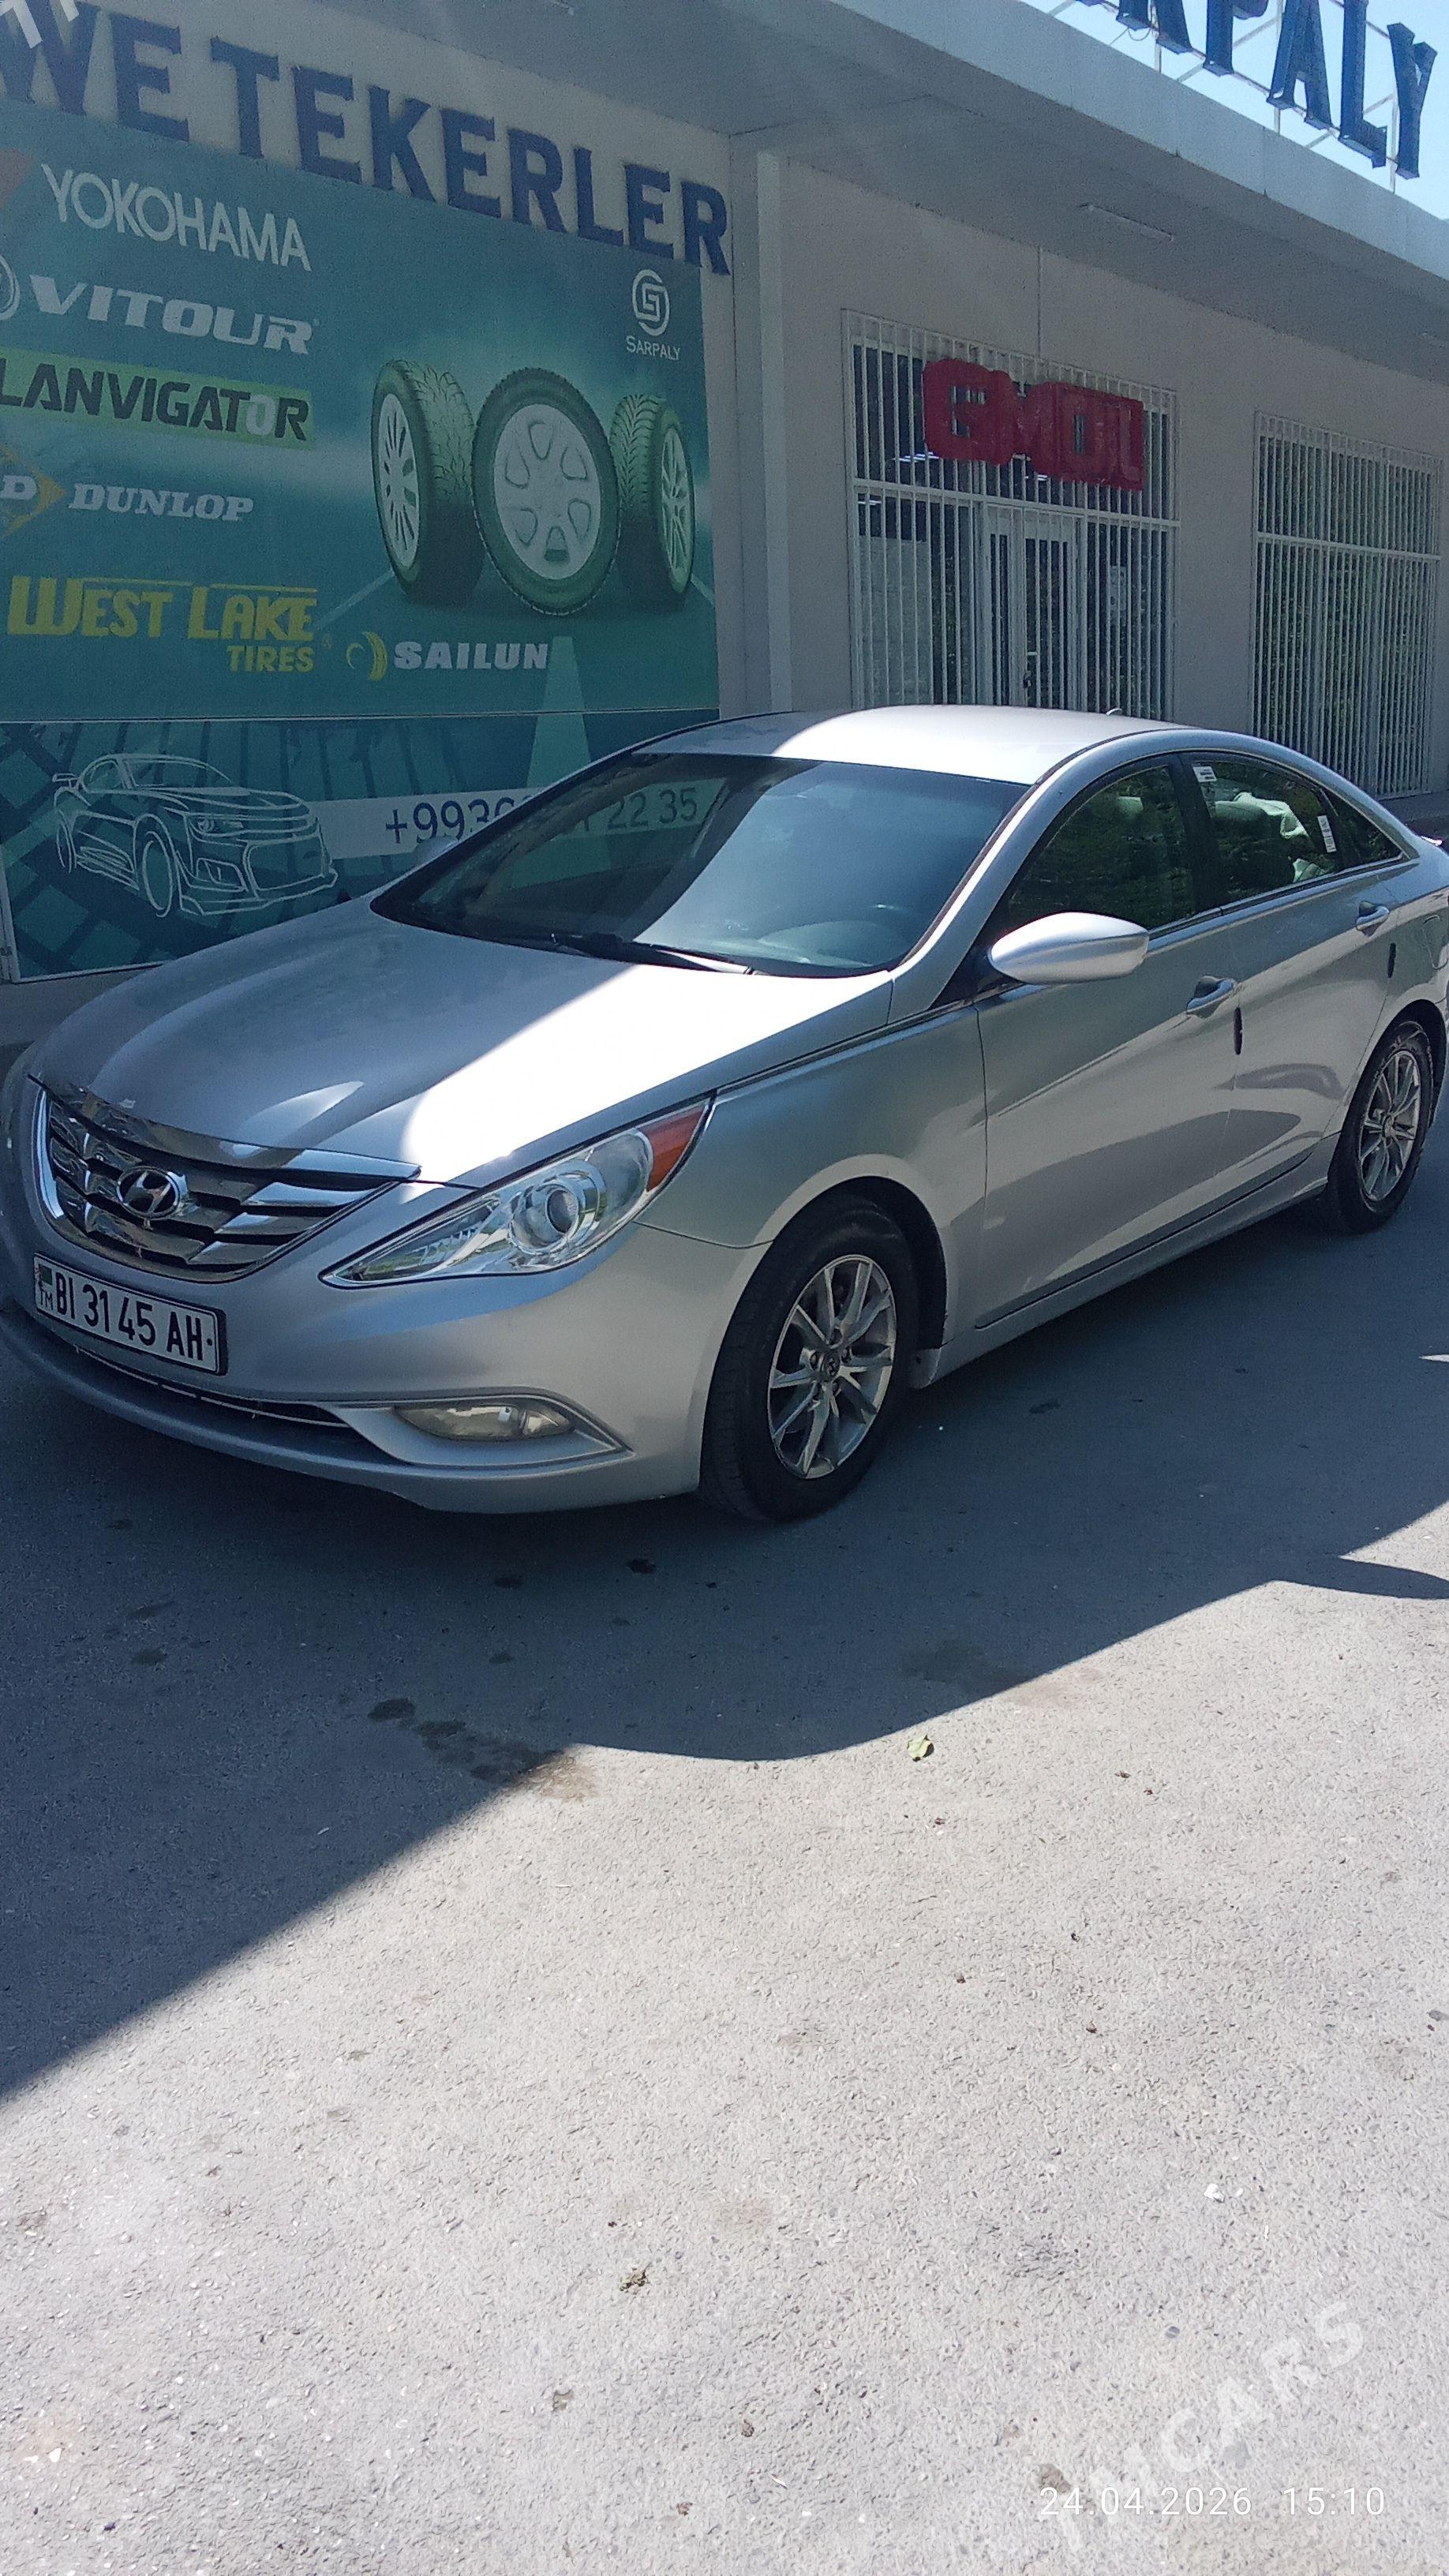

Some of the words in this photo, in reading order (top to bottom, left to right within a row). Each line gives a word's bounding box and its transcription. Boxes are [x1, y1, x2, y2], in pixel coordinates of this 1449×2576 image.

[210, 35, 731, 275] TEKERLER
[41, 163, 312, 271] YOKOHAMA
[29, 275, 313, 354] VITOUR
[626, 335, 680, 361] SARPALY
[0, 358, 309, 441] LANVIGATOR
[68, 482, 253, 521] DUNLOP
[7, 575, 173, 638] WEST
[188, 586, 317, 641] LAKE
[227, 645, 314, 672] TIRES
[395, 641, 549, 669] SAILUN
[608, 792, 649, 829] 22
[658, 788, 698, 824] 35
[40, 1288, 54, 1310] TM
[55, 1271, 75, 1320] BI
[82, 1284, 110, 1333] 31
[118, 1297, 155, 1346] 45
[167, 1312, 203, 1361] AH
